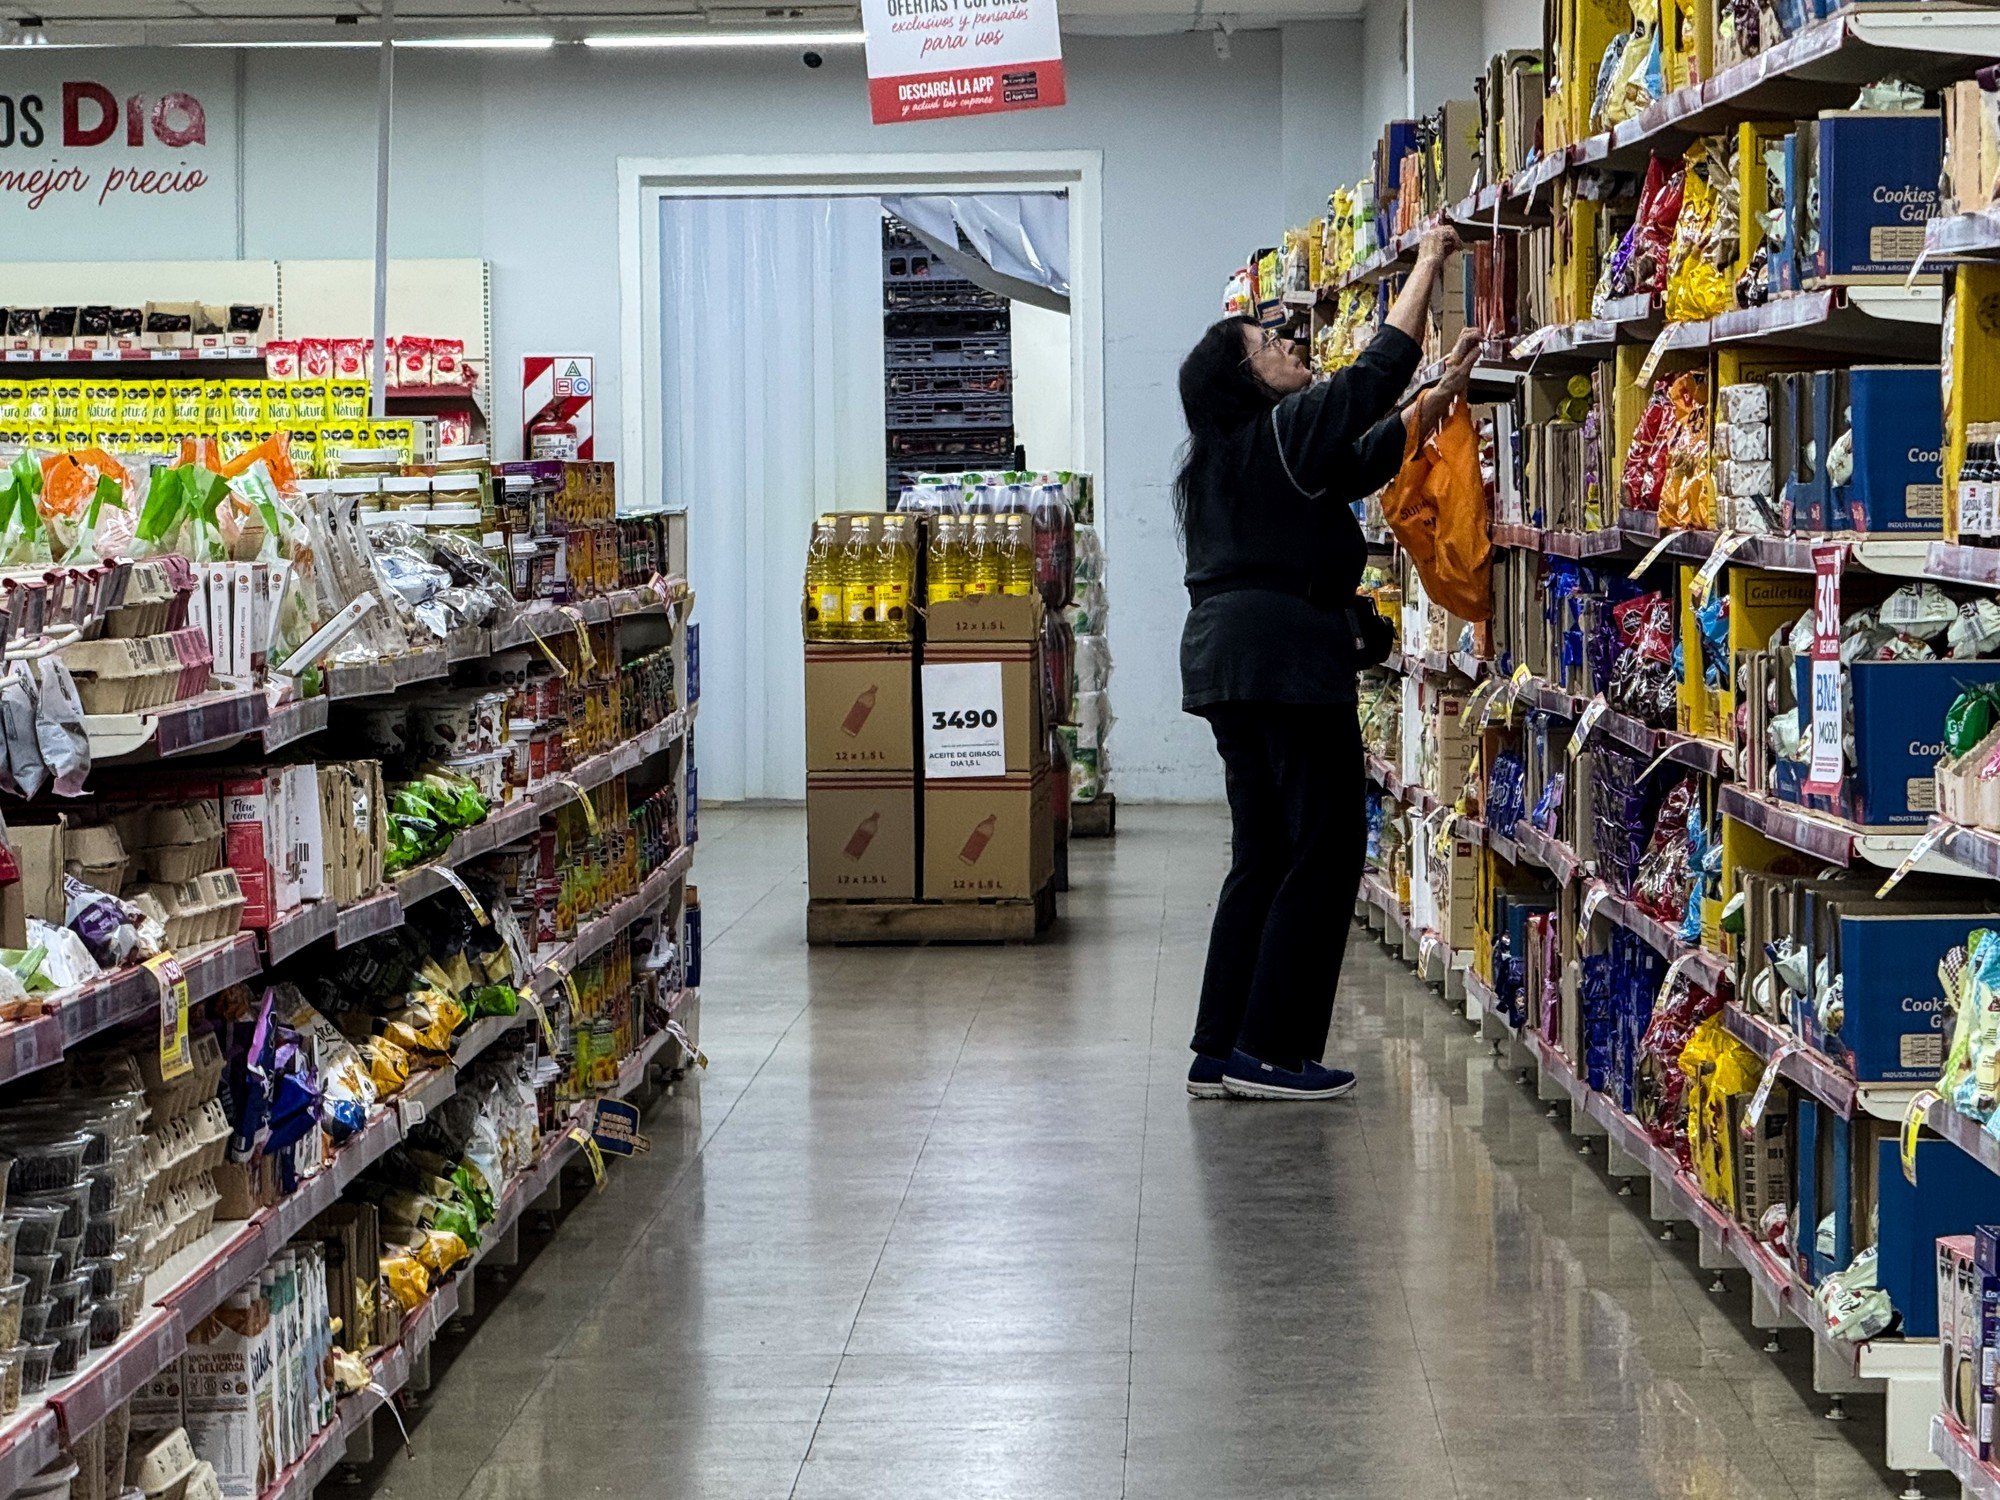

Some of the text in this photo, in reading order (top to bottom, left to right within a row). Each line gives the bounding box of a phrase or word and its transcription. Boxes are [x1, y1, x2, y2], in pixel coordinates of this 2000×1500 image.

[972, 5, 1028, 29] pensados
[920, 29, 1004, 58] para vos
[957, 79, 974, 95] LA
[973, 76, 994, 92] APP
[99, 161, 208, 206] precio
[1873, 185, 1936, 203] Cookies
[932, 709, 998, 730] 3490
[835, 752, 847, 760] 12
[969, 750, 1001, 758] GIRASOL
[838, 876, 849, 884] 12
[953, 881, 964, 889] 12
